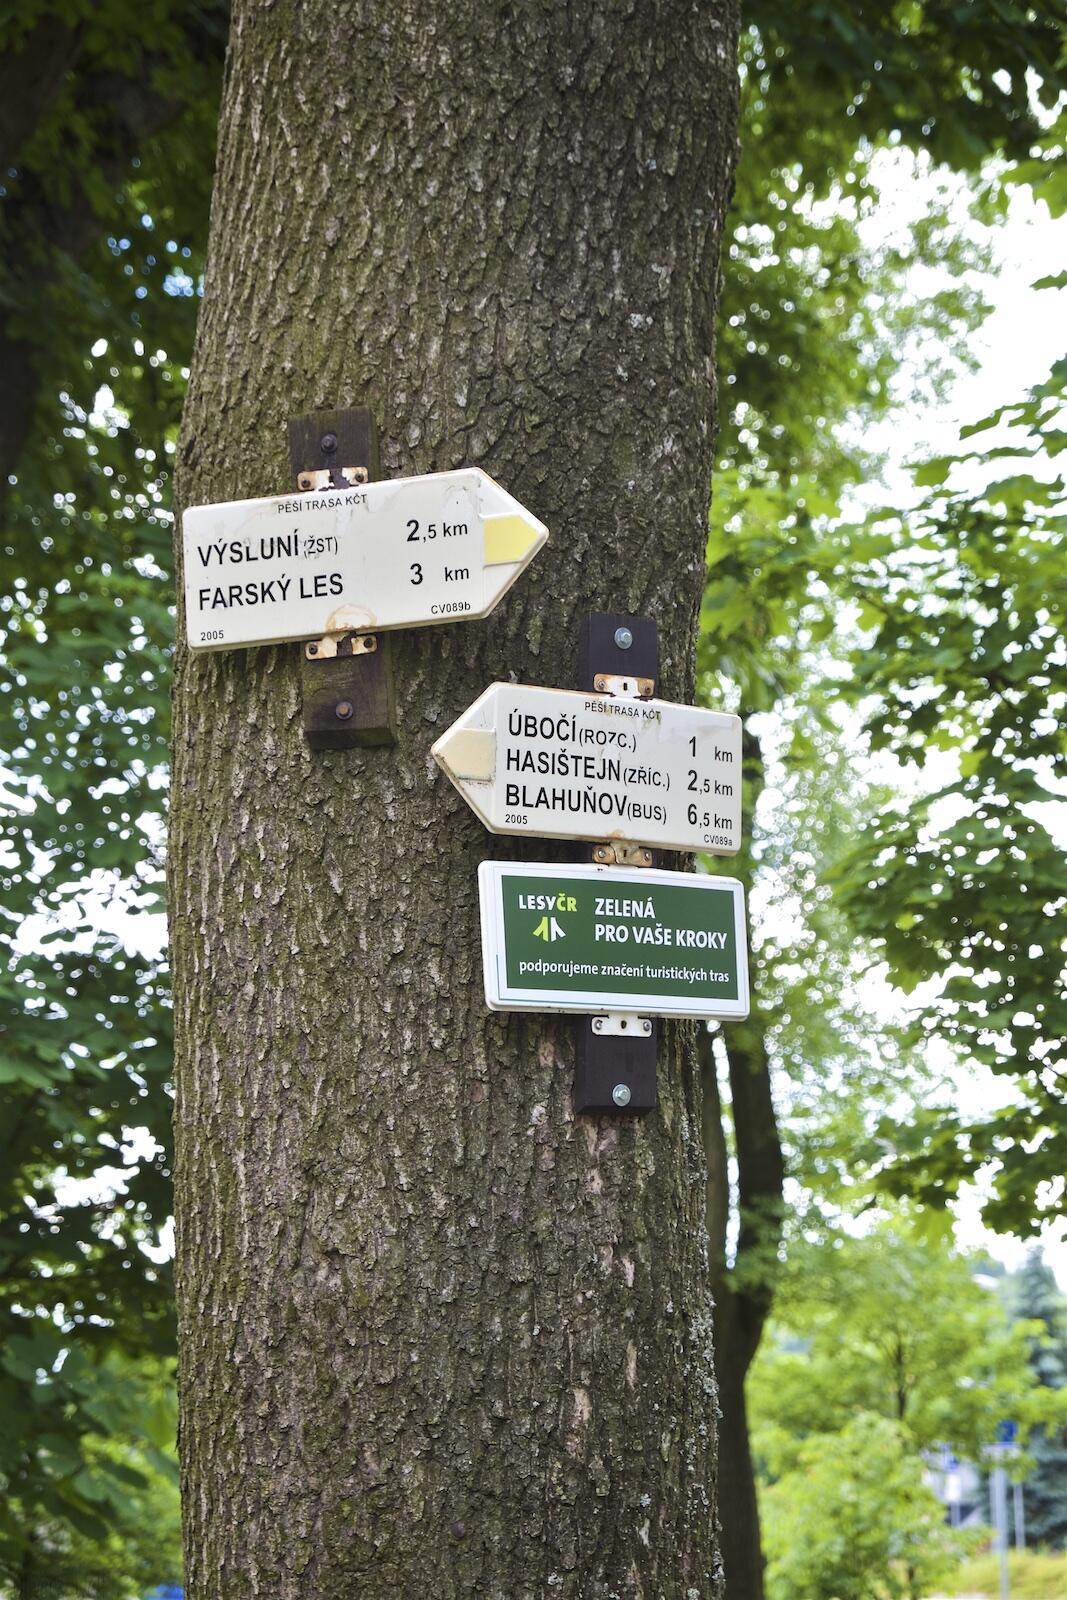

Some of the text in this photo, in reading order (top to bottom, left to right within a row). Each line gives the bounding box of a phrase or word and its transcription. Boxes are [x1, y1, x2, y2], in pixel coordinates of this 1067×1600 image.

[278, 494, 367, 513] PĚŠÍ TRASA KČT
[406, 519, 437, 543] 2,5
[443, 522, 468, 537] km
[199, 563, 469, 611] FARSKÝ LES 3 km
[431, 602, 470, 614] CV089b
[200, 630, 224, 641] 2005
[608, 705, 639, 718] TRASA
[689, 736, 696, 758] 1
[715, 746, 733, 763] km
[687, 769, 710, 793] 2,5
[715, 779, 733, 796] km
[505, 814, 528, 825] 2005
[687, 803, 710, 827] 6,5
[714, 813, 732, 830] km
[704, 834, 732, 846] CV089a
[595, 897, 655, 918] ZELENÁ
[595, 923, 727, 950] PRO VAŠE KROKY
[519, 959, 729, 983] podporujeme značení turistických tras
